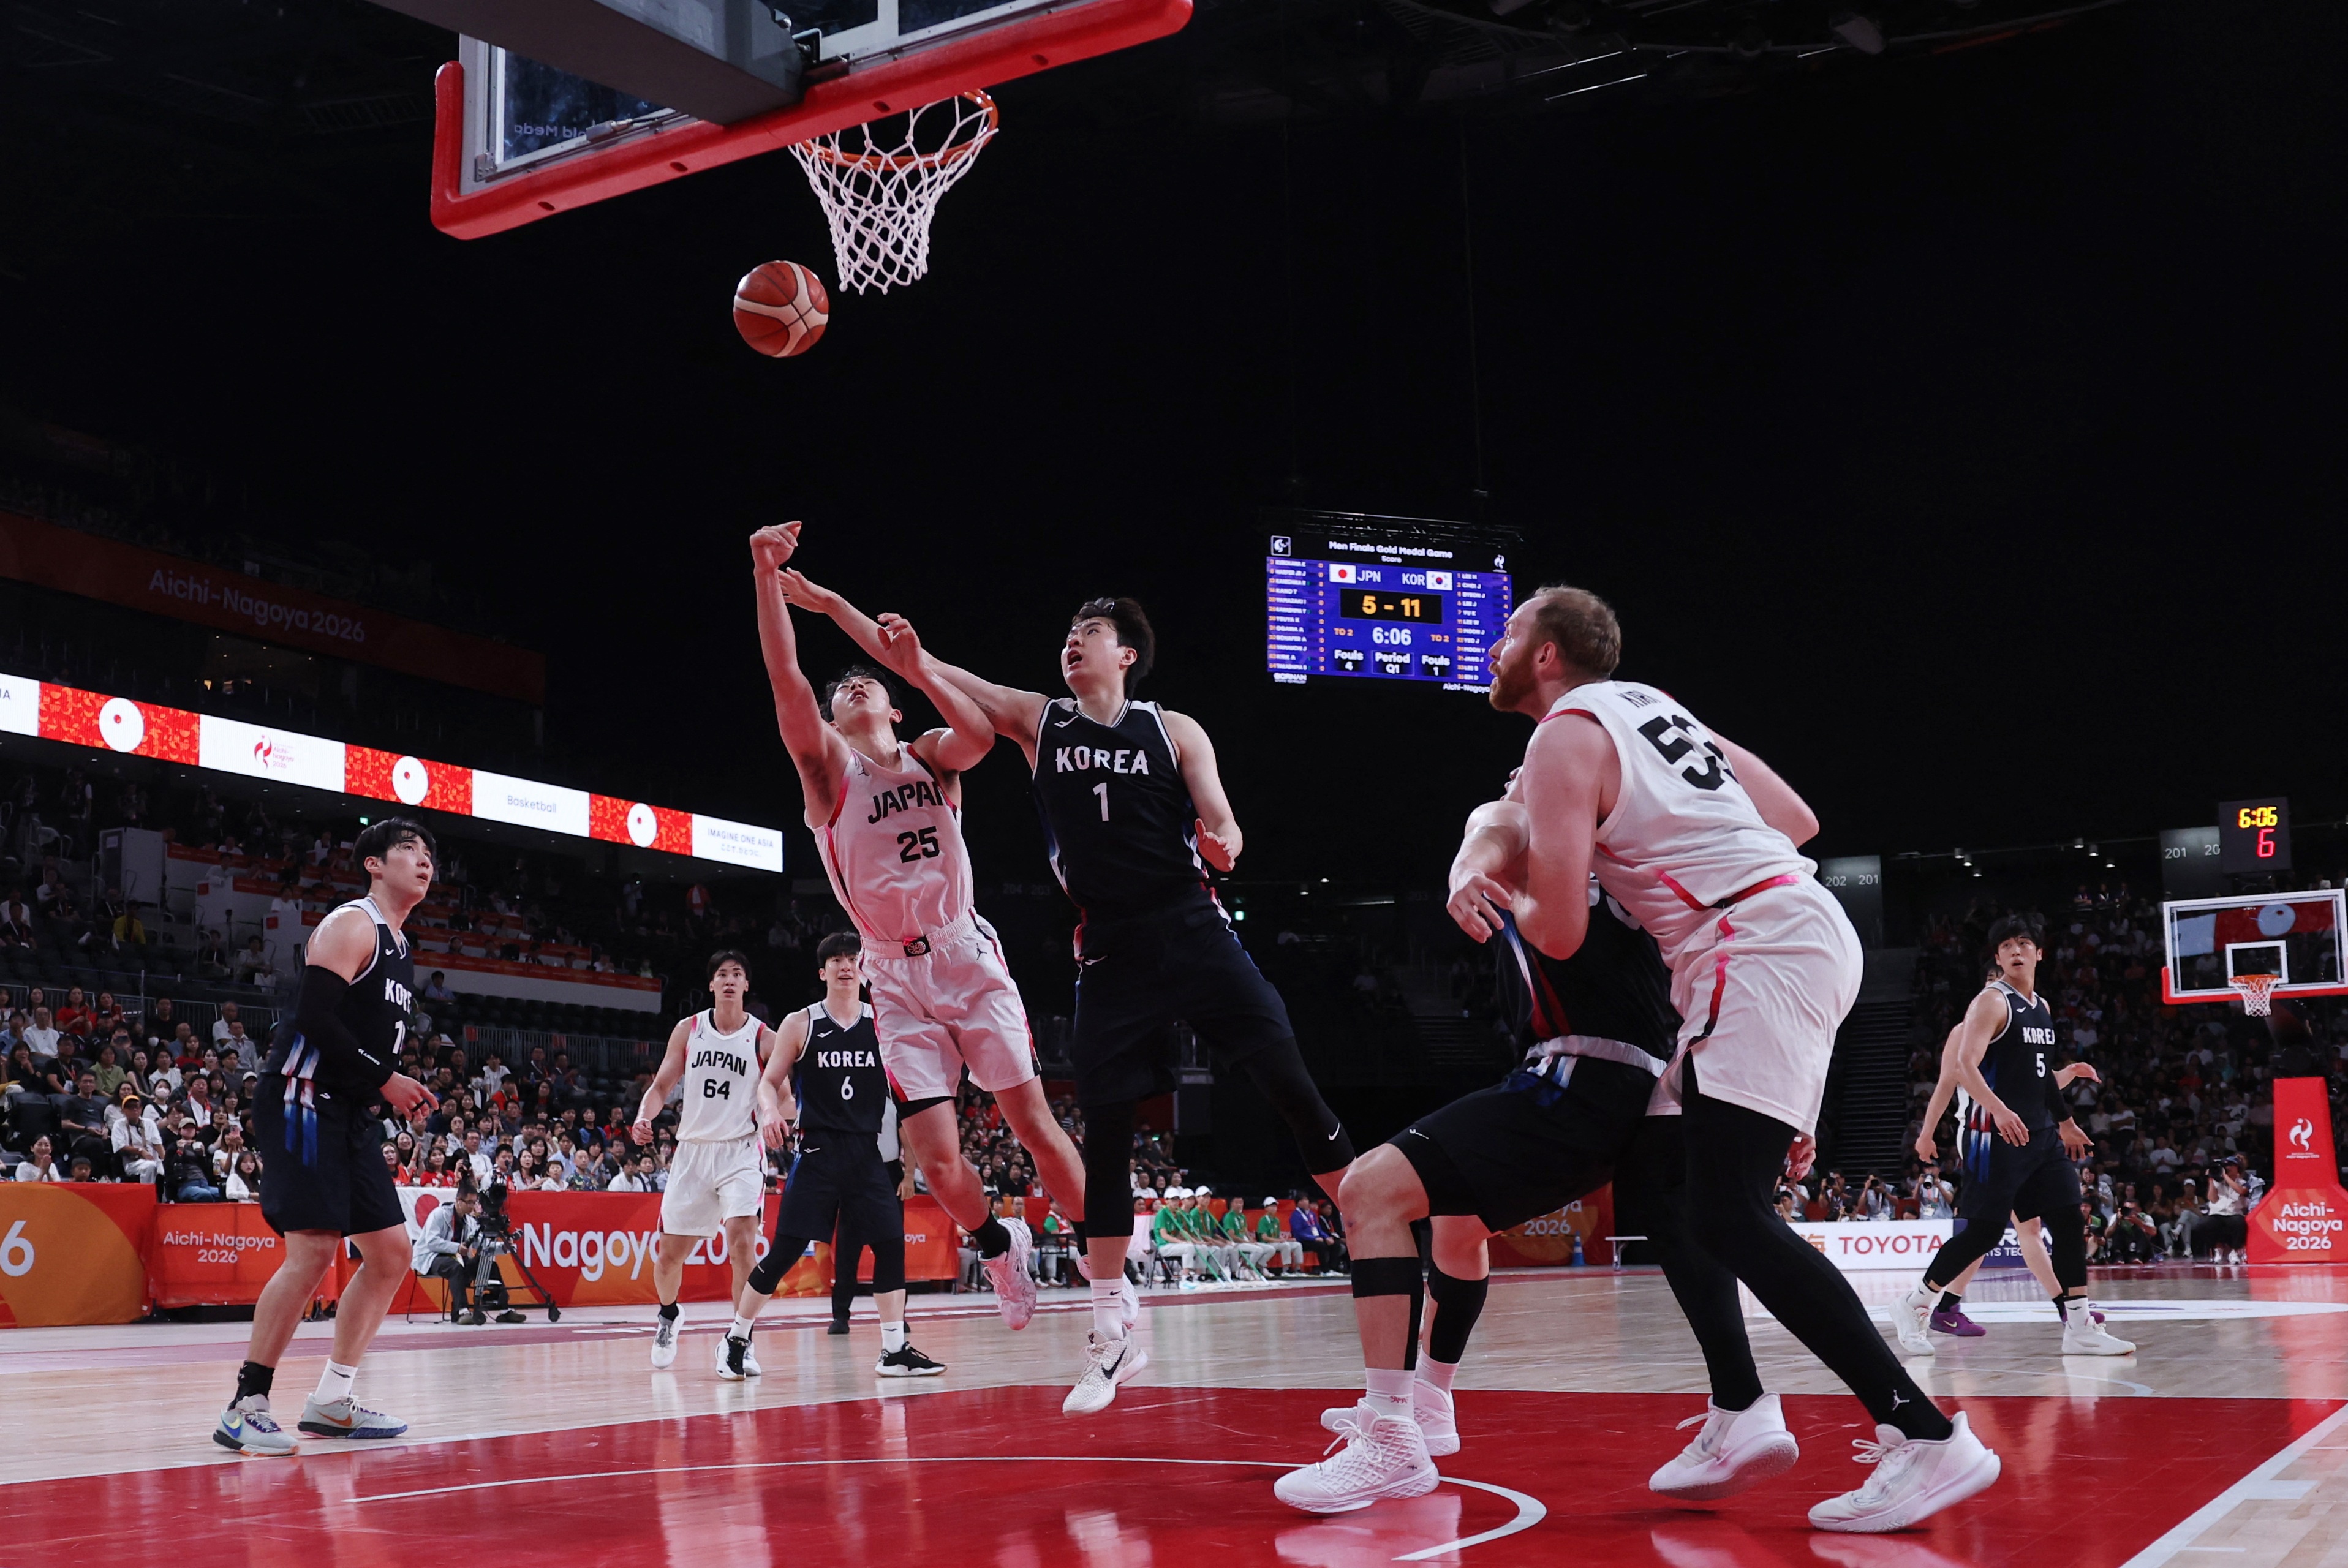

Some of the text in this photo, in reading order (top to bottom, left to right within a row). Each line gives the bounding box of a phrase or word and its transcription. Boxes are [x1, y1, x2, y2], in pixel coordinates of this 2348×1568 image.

[1329, 541, 1453, 559] Men Finals Gold Medal Game
[1357, 570, 1381, 582] JPN
[1402, 573, 1425, 586] KOR
[149, 570, 365, 643] Aichi-Nagoya 2026
[1362, 595, 1377, 615] 5
[1400, 598, 1421, 617] 11
[1372, 627, 1412, 646] 6:06
[1334, 649, 1364, 660] Fouls
[1375, 652, 1410, 663] Period
[1421, 655, 1451, 666] Fouls
[1345, 661, 1353, 671] 4
[1386, 663, 1400, 674] Q1
[1433, 666, 1439, 676] 1
[1056, 745, 1149, 775] KOREA
[507, 795, 557, 813] Basketball
[1092, 782, 1109, 821] 1
[2238, 806, 2278, 829] 6:06
[708, 828, 773, 848] IMAGINE ONE ASIA
[897, 826, 940, 864] 25
[2257, 828, 2275, 858] 6
[2165, 847, 2186, 859] 201
[1825, 874, 1879, 887] 202 201
[692, 1050, 747, 1077] JAPAN
[818, 1050, 876, 1068] KOREA
[2036, 1051, 2047, 1078] 5
[703, 1079, 730, 1100] 64
[840, 1076, 854, 1101] 6
[2281, 1202, 2335, 1218] Aichi-
[1524, 1219, 1571, 1235] 2026
[2273, 1219, 2343, 1235] Nagoya
[163, 1231, 275, 1252] Aichi-Nagoya
[1839, 1235, 1944, 1254] TOYOTA
[2286, 1236, 2332, 1251] 2026
[197, 1249, 238, 1264] 2026
